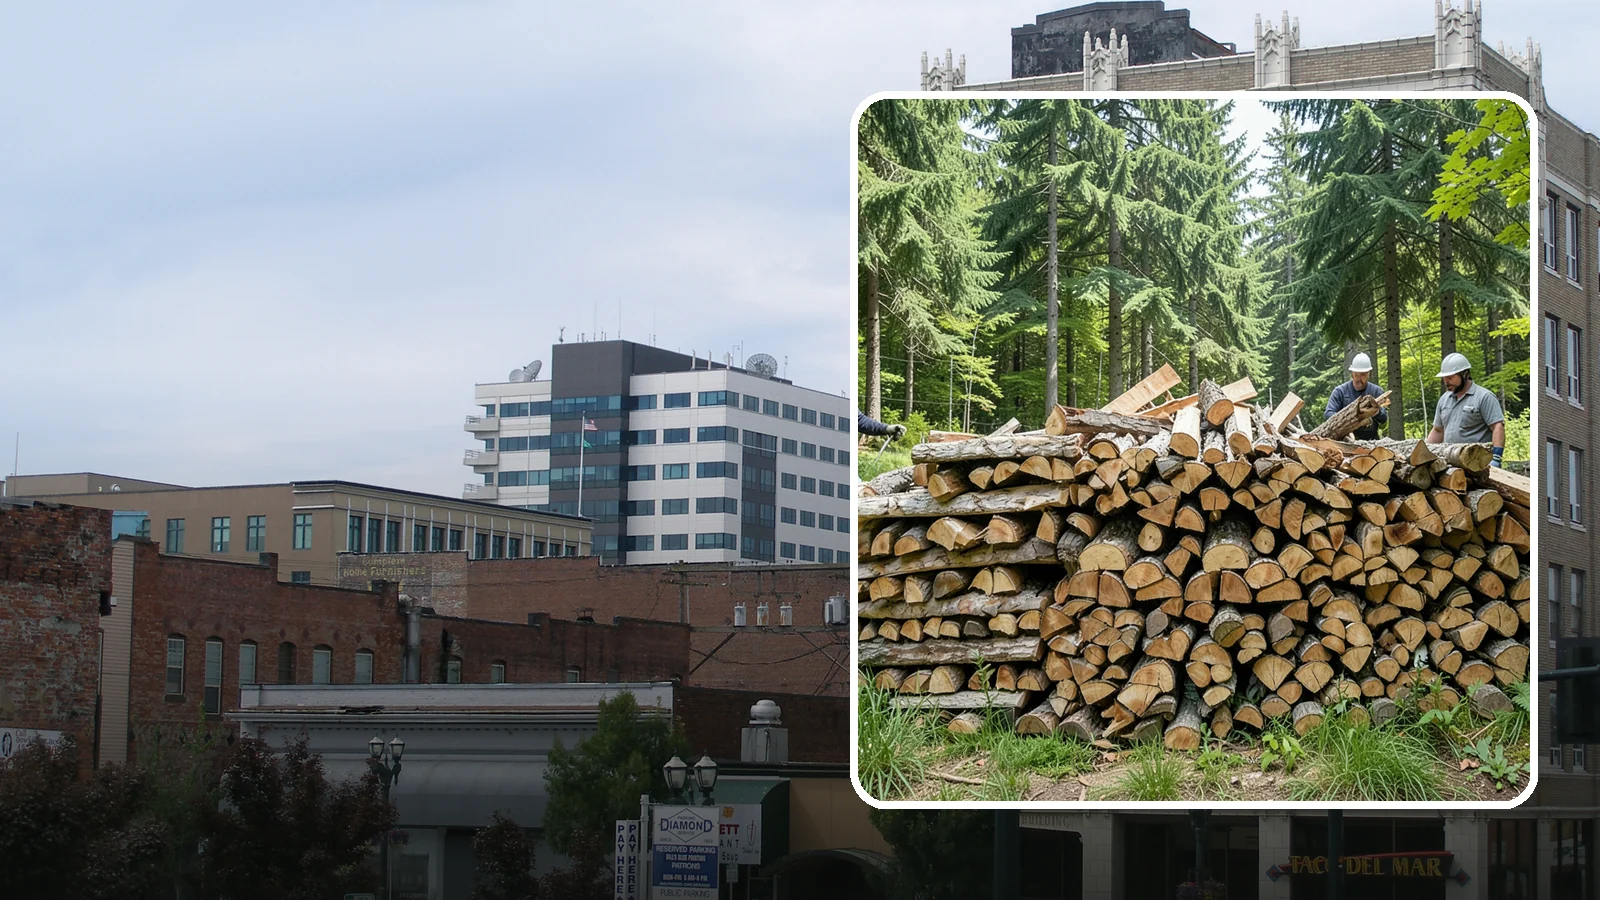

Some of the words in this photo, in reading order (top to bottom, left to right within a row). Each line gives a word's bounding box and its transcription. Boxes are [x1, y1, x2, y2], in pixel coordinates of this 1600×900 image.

[370, 566, 427, 576] Furnishers
[660, 818, 713, 832] DIAMOND
[1022, 815, 1070, 827] BUILDING
[719, 824, 740, 835] ETT
[617, 825, 625, 852] PAY
[628, 824, 637, 852] PAY
[719, 839, 739, 848] ANT
[656, 845, 687, 853] RESERVED
[689, 846, 716, 854] PARKING
[721, 851, 739, 862] Soup
[671, 862, 701, 870] PATRONS
[1288, 855, 1330, 874] TAC
[1346, 856, 1385, 875] DEL
[1392, 857, 1443, 877] MAR
[616, 856, 625, 893] HERE
[627, 855, 636, 893] HERE
[660, 888, 682, 897] PUBLIC
[683, 889, 710, 898] PARKING
